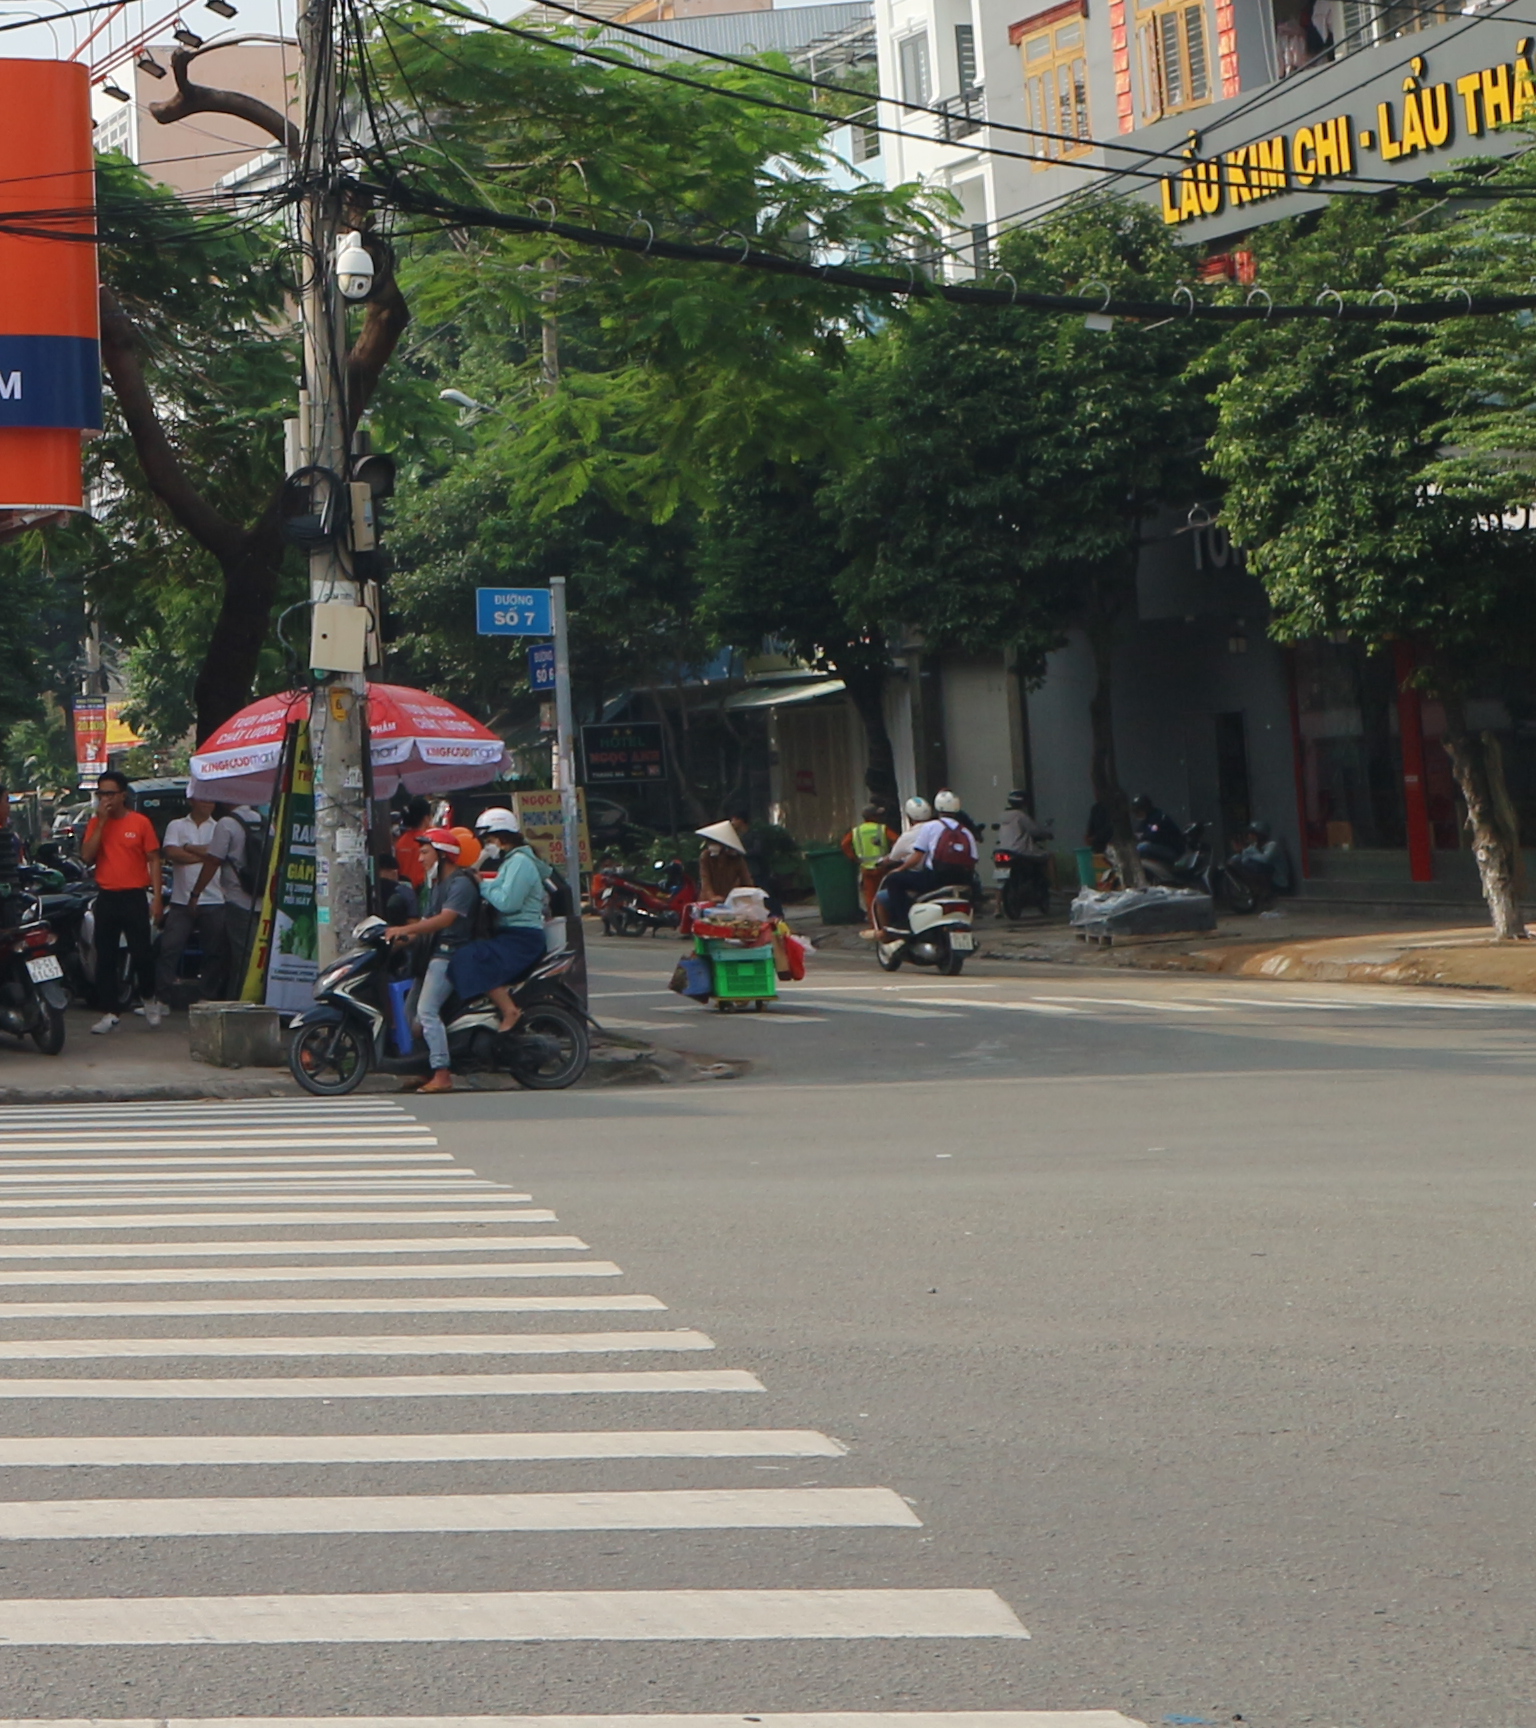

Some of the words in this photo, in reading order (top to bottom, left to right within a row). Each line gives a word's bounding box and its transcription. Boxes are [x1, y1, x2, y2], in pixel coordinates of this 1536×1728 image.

[1160, 131, 1220, 225] LẨU
[1228, 134, 1288, 207] KIM
[1293, 115, 1352, 185] CHI
[1378, 57, 1450, 161] LẨU
[494, 592, 534, 607] ĐƯỜNG
[493, 606, 522, 627] SỐ
[525, 611, 535, 627] 7
